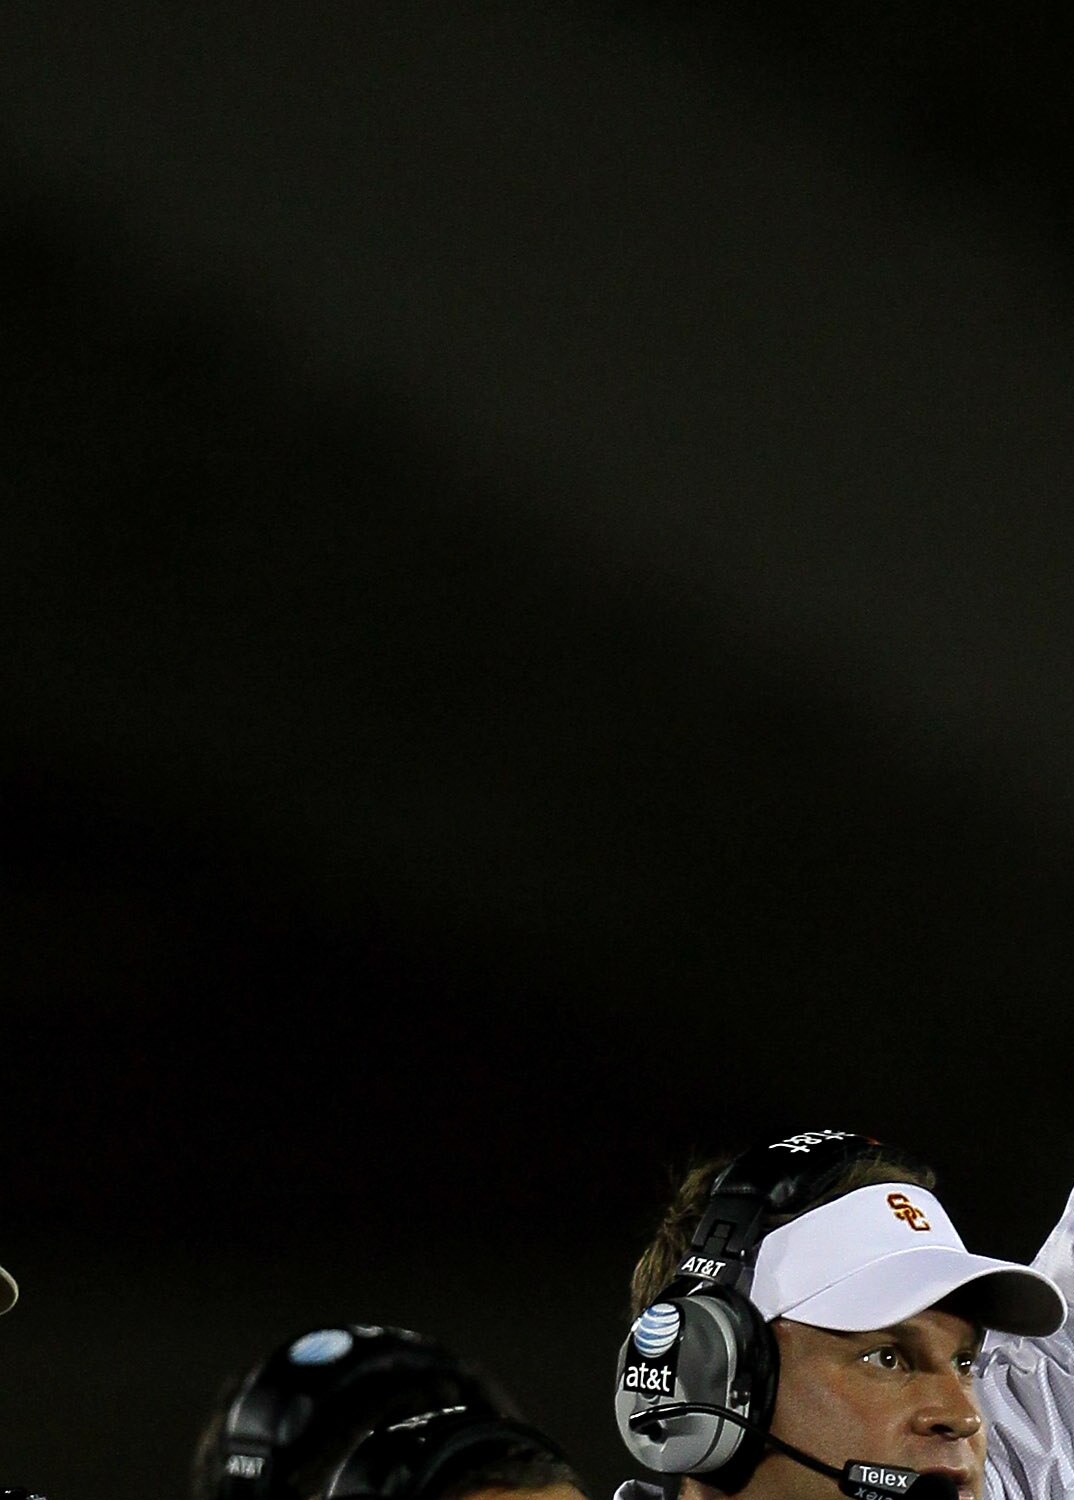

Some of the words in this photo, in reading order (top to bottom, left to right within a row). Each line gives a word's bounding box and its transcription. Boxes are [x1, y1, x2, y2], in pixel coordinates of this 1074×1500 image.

[886, 1192, 931, 1232] SC
[681, 1256, 727, 1277] AT&T
[626, 1362, 673, 1393] at&t
[859, 1465, 909, 1488] Telex
